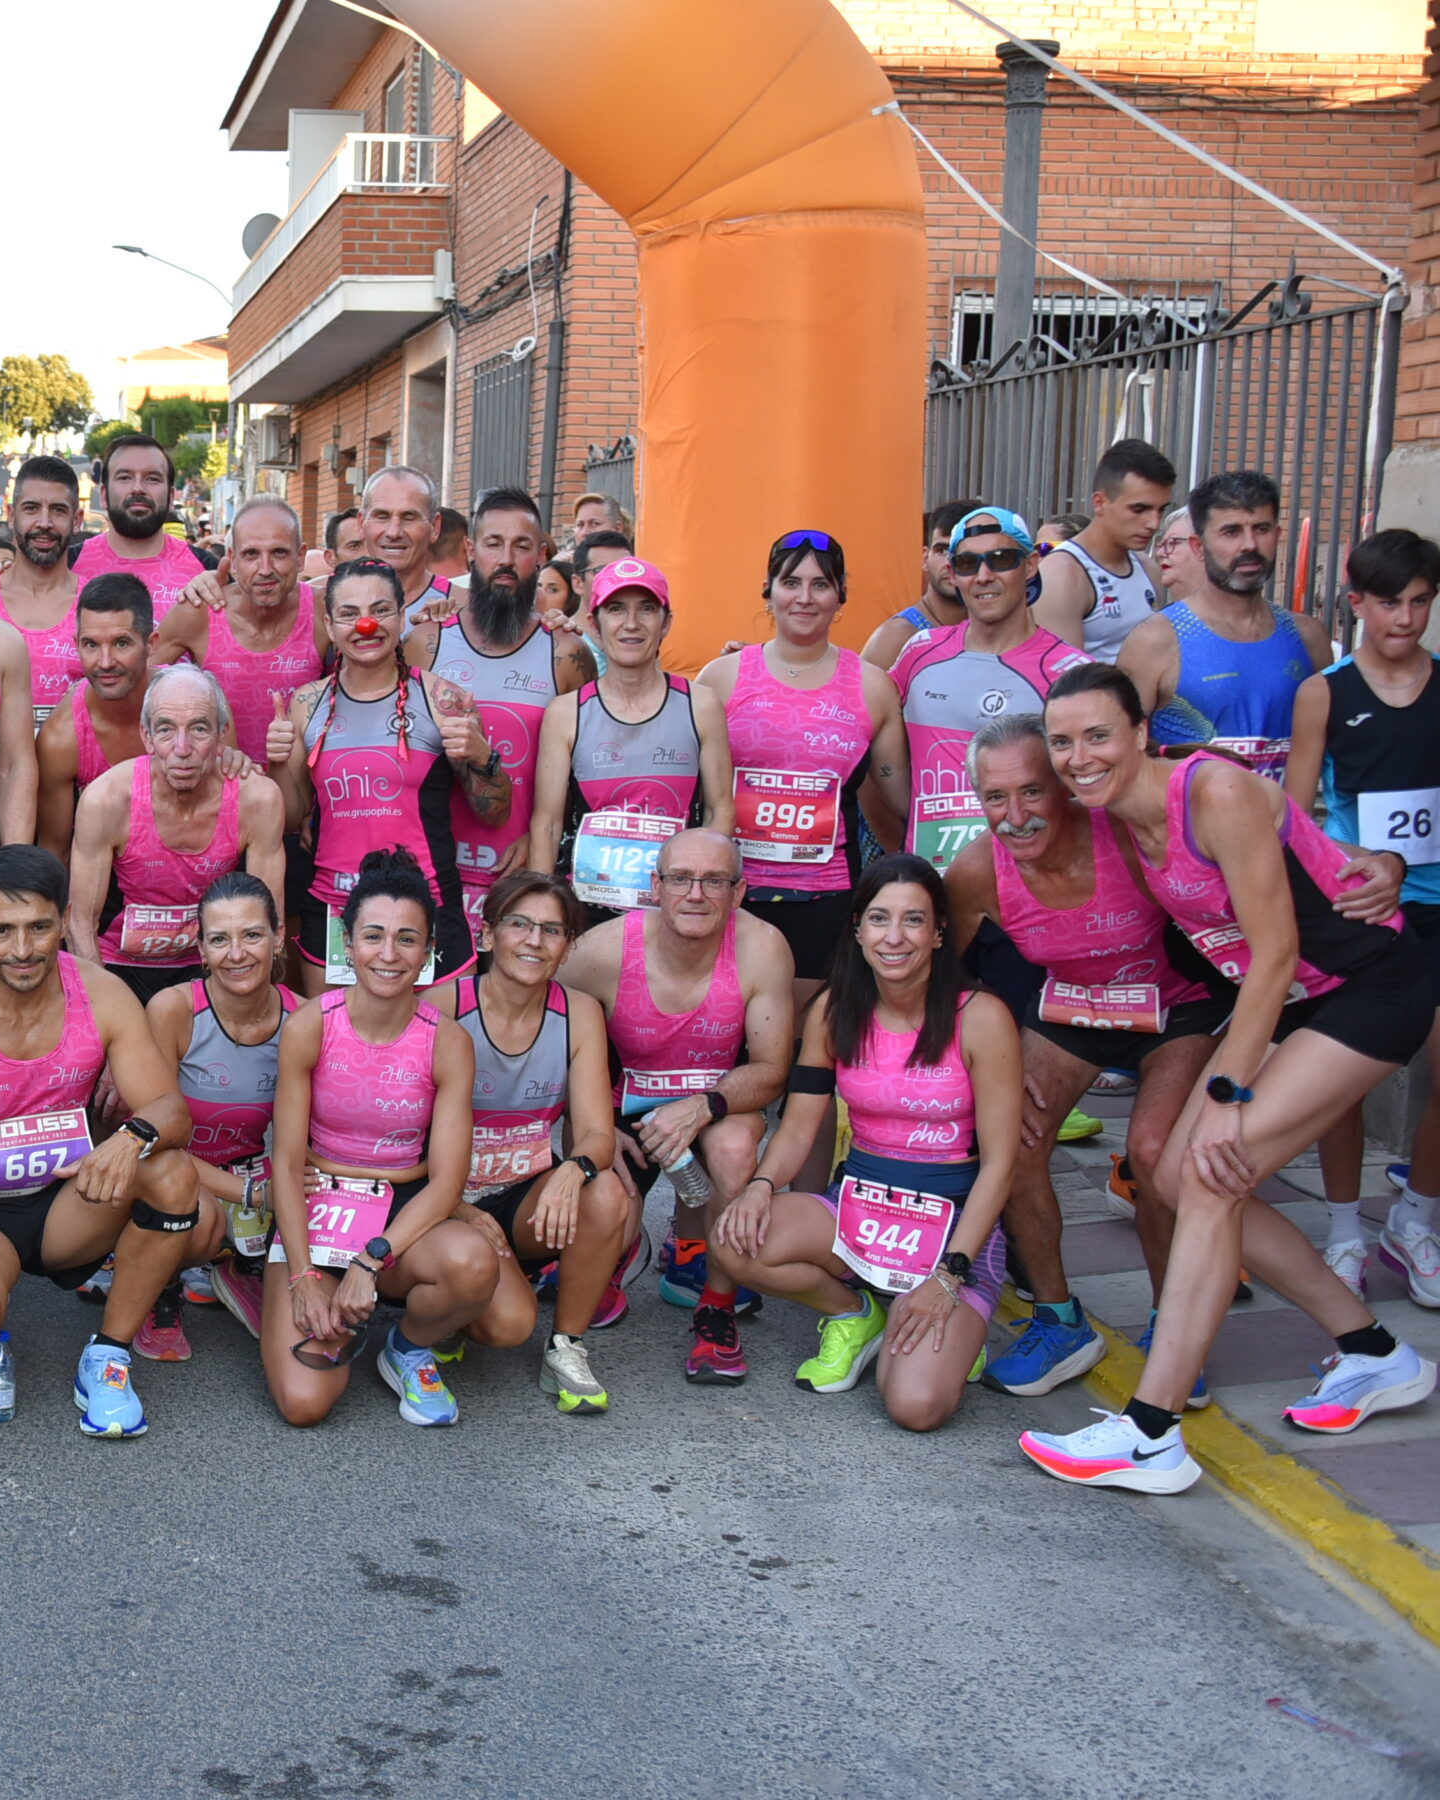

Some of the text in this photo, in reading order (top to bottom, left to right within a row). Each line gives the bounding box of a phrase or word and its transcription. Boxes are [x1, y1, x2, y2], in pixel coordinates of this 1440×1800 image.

[153, 584, 182, 599] PHI
[44, 638, 80, 657] PHIG
[269, 654, 309, 670] PHIGP
[504, 670, 549, 689] PHIGP
[809, 700, 856, 722] PHIGP
[652, 747, 689, 761] PHIGP
[745, 773, 831, 791] SOLISS
[332, 806, 402, 819] www.grupophi.es
[923, 796, 982, 814] SOLIS
[755, 801, 815, 830] 896
[1387, 809, 1432, 840] 26
[589, 817, 676, 836] SOLISS
[771, 831, 799, 841] Gemma
[743, 841, 776, 850] SKODA
[587, 885, 621, 894] SKODA
[135, 909, 198, 923] SOLIS
[1086, 910, 1138, 931] PHIGP
[1053, 981, 1146, 1004] SOLISS
[692, 1017, 738, 1035] PHIGP
[49, 1066, 97, 1086] PHIGP
[380, 1065, 419, 1080] PHIGP
[525, 1080, 564, 1096] PHIGP
[634, 1075, 718, 1090] SOLISS
[29, 1134, 50, 1142] desde
[473, 1120, 544, 1140] OLISS
[5, 1147, 68, 1180] 667
[850, 1184, 943, 1217] SOLISS
[861, 1202, 887, 1213] Seguros
[889, 1208, 910, 1217] desde
[308, 1203, 356, 1234] 211
[315, 1234, 335, 1243] Clara
[855, 1219, 922, 1256] 944
[864, 1251, 880, 1262] Ana
